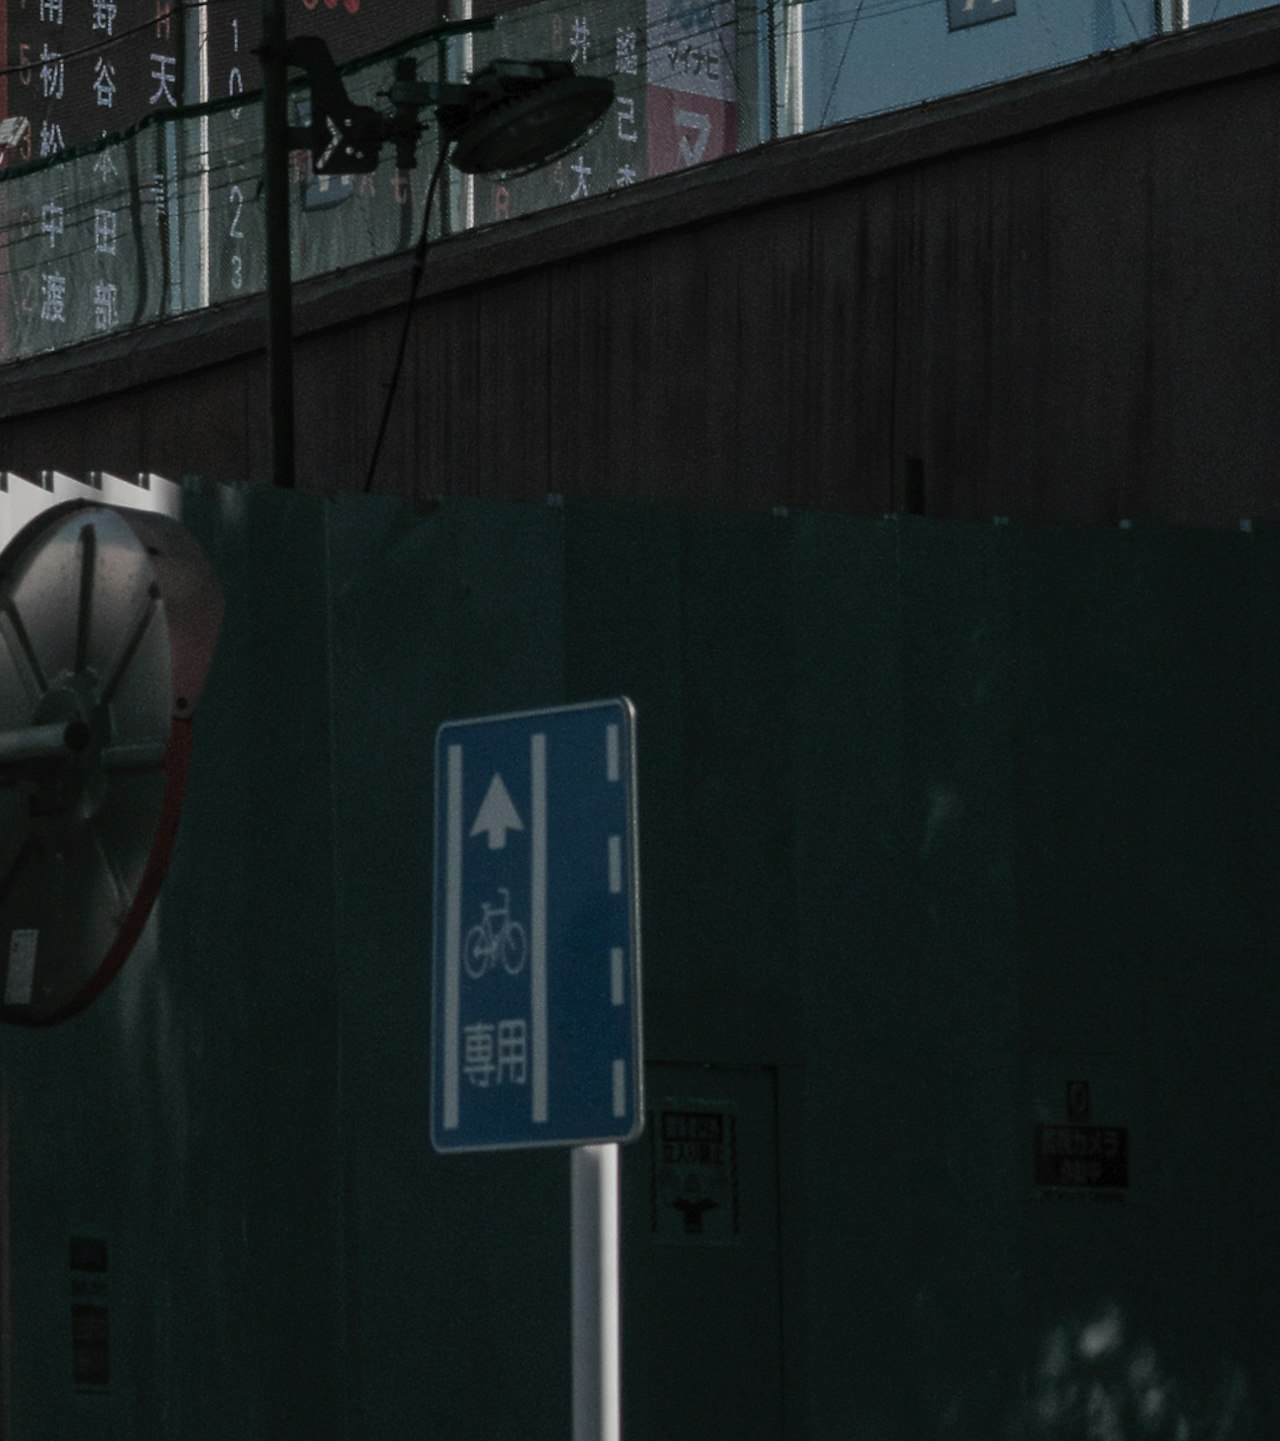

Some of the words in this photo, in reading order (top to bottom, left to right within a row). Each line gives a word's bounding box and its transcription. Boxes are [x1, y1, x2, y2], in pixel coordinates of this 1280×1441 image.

[230, 19, 238, 52] 1
[148, 53, 178, 107] 天
[462, 1018, 528, 1089] 専用
